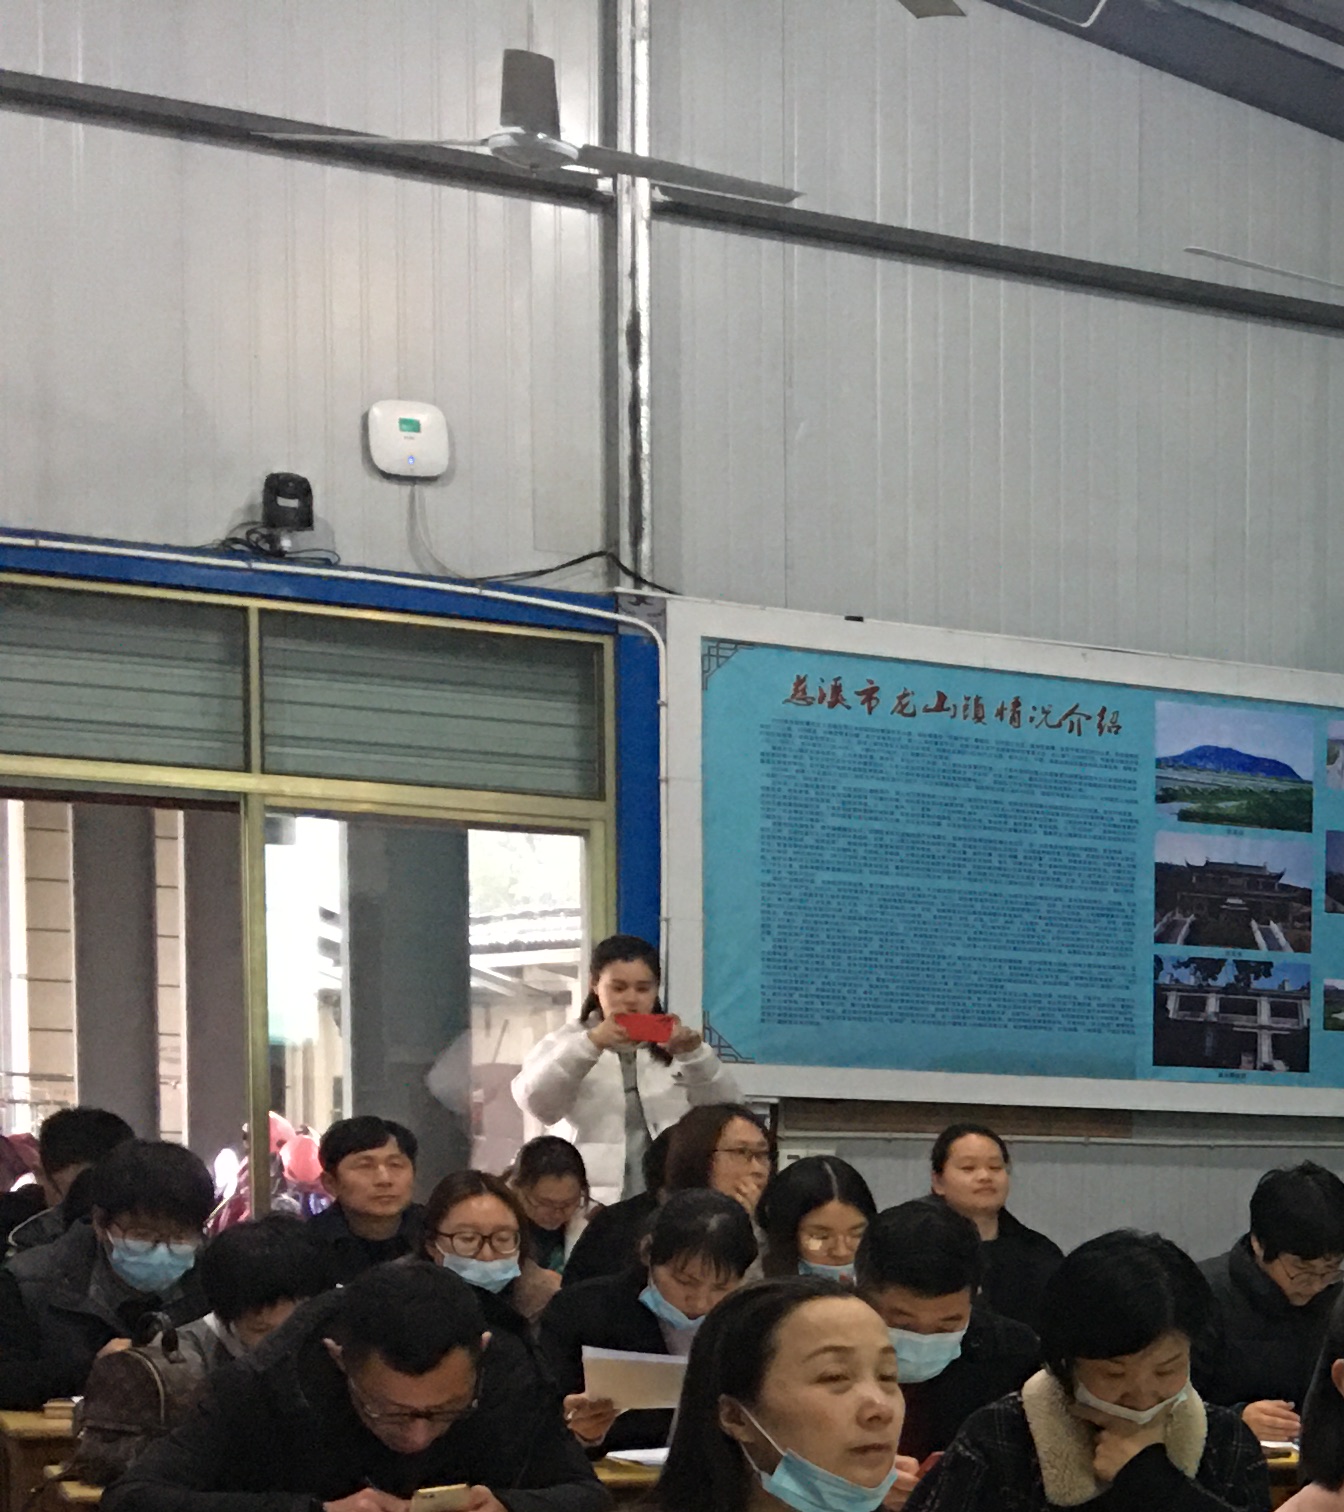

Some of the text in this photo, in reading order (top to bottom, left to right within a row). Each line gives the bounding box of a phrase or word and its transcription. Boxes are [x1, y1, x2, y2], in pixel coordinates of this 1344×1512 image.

[781, 674, 1122, 737] 慈溪市龙山镇情况介绍
